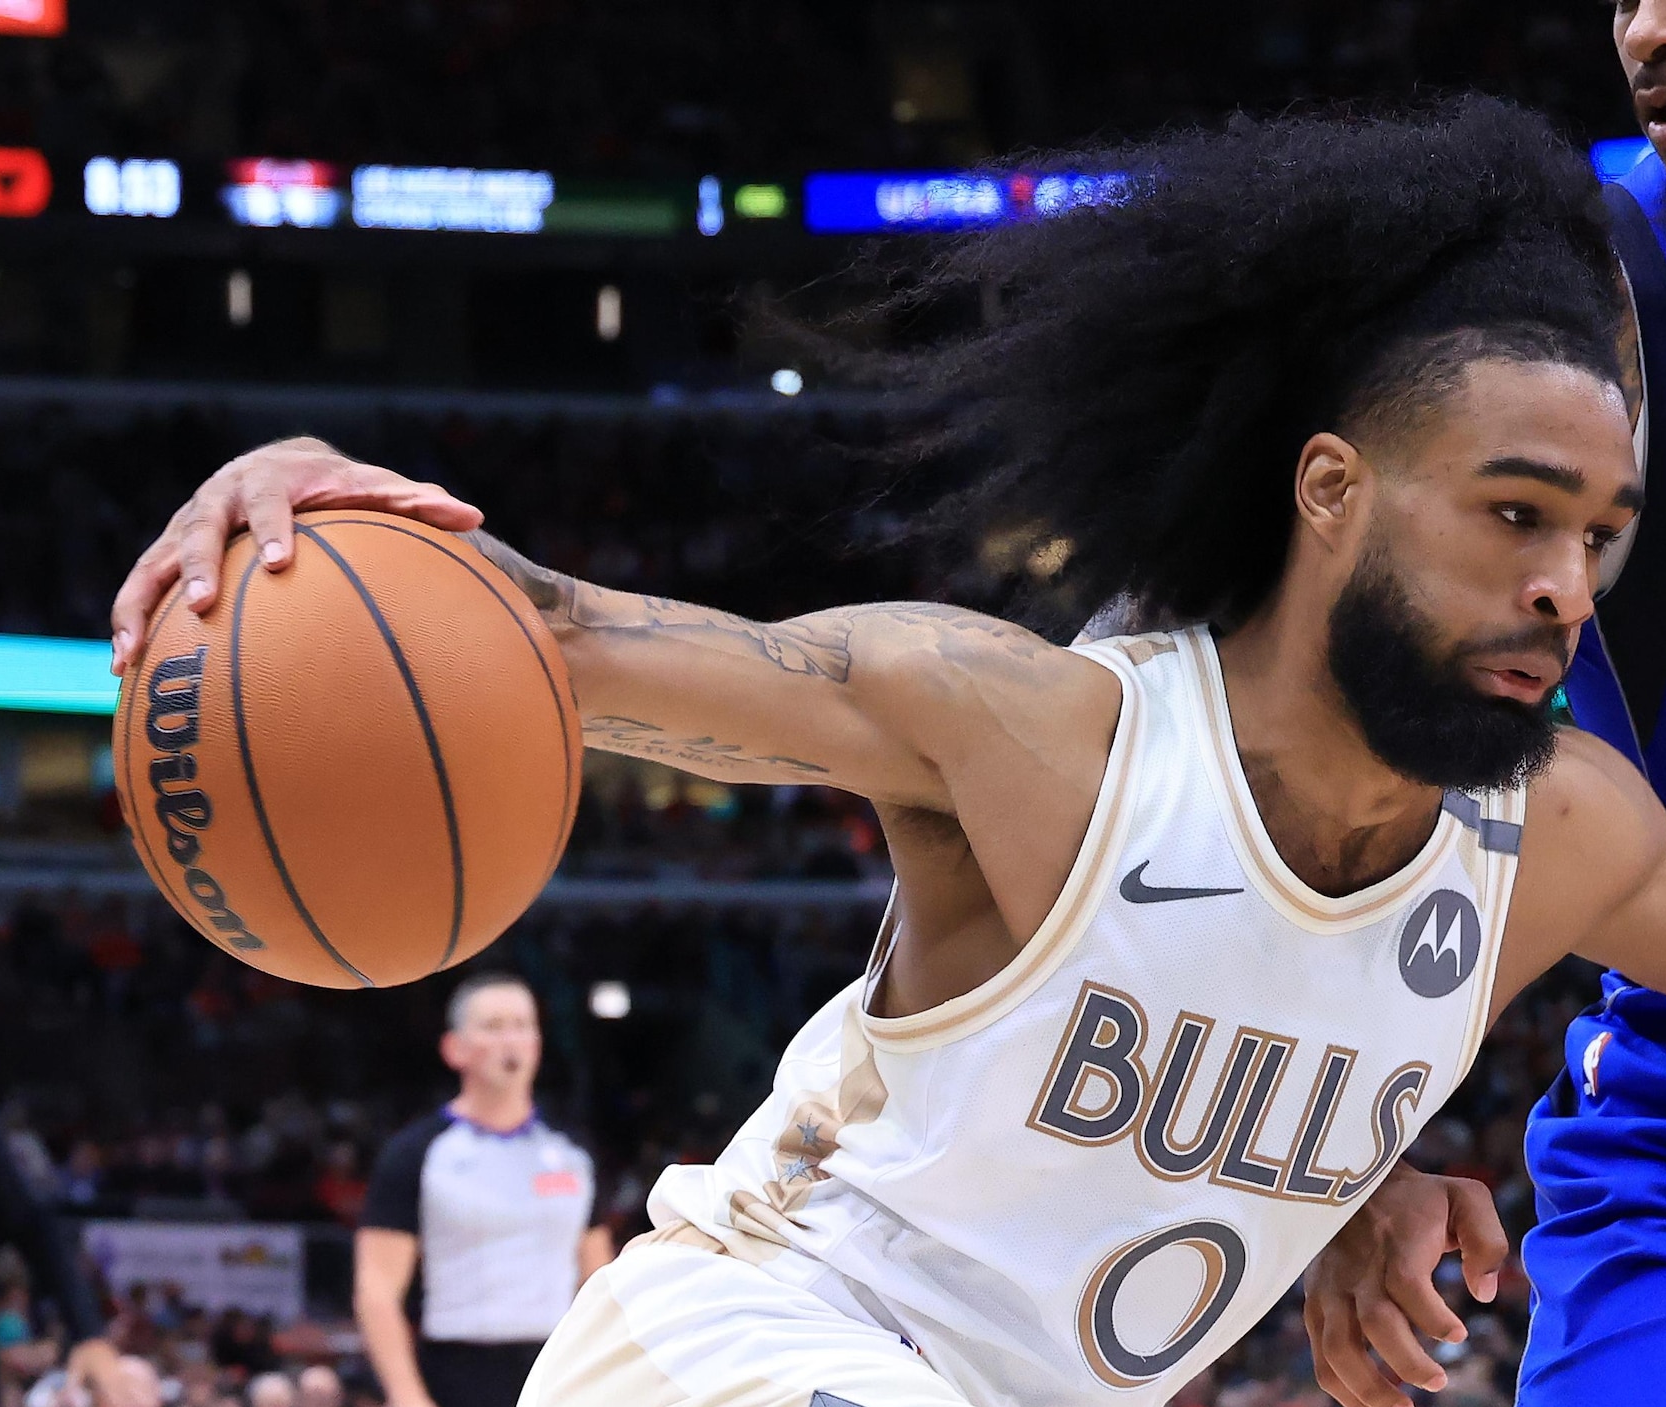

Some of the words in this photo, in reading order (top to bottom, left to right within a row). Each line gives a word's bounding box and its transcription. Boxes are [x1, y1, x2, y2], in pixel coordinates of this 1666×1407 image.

[145, 645, 267, 951] Wilson
[1025, 979, 1432, 1207] BULLS
[1074, 1218, 1247, 1391] 0
